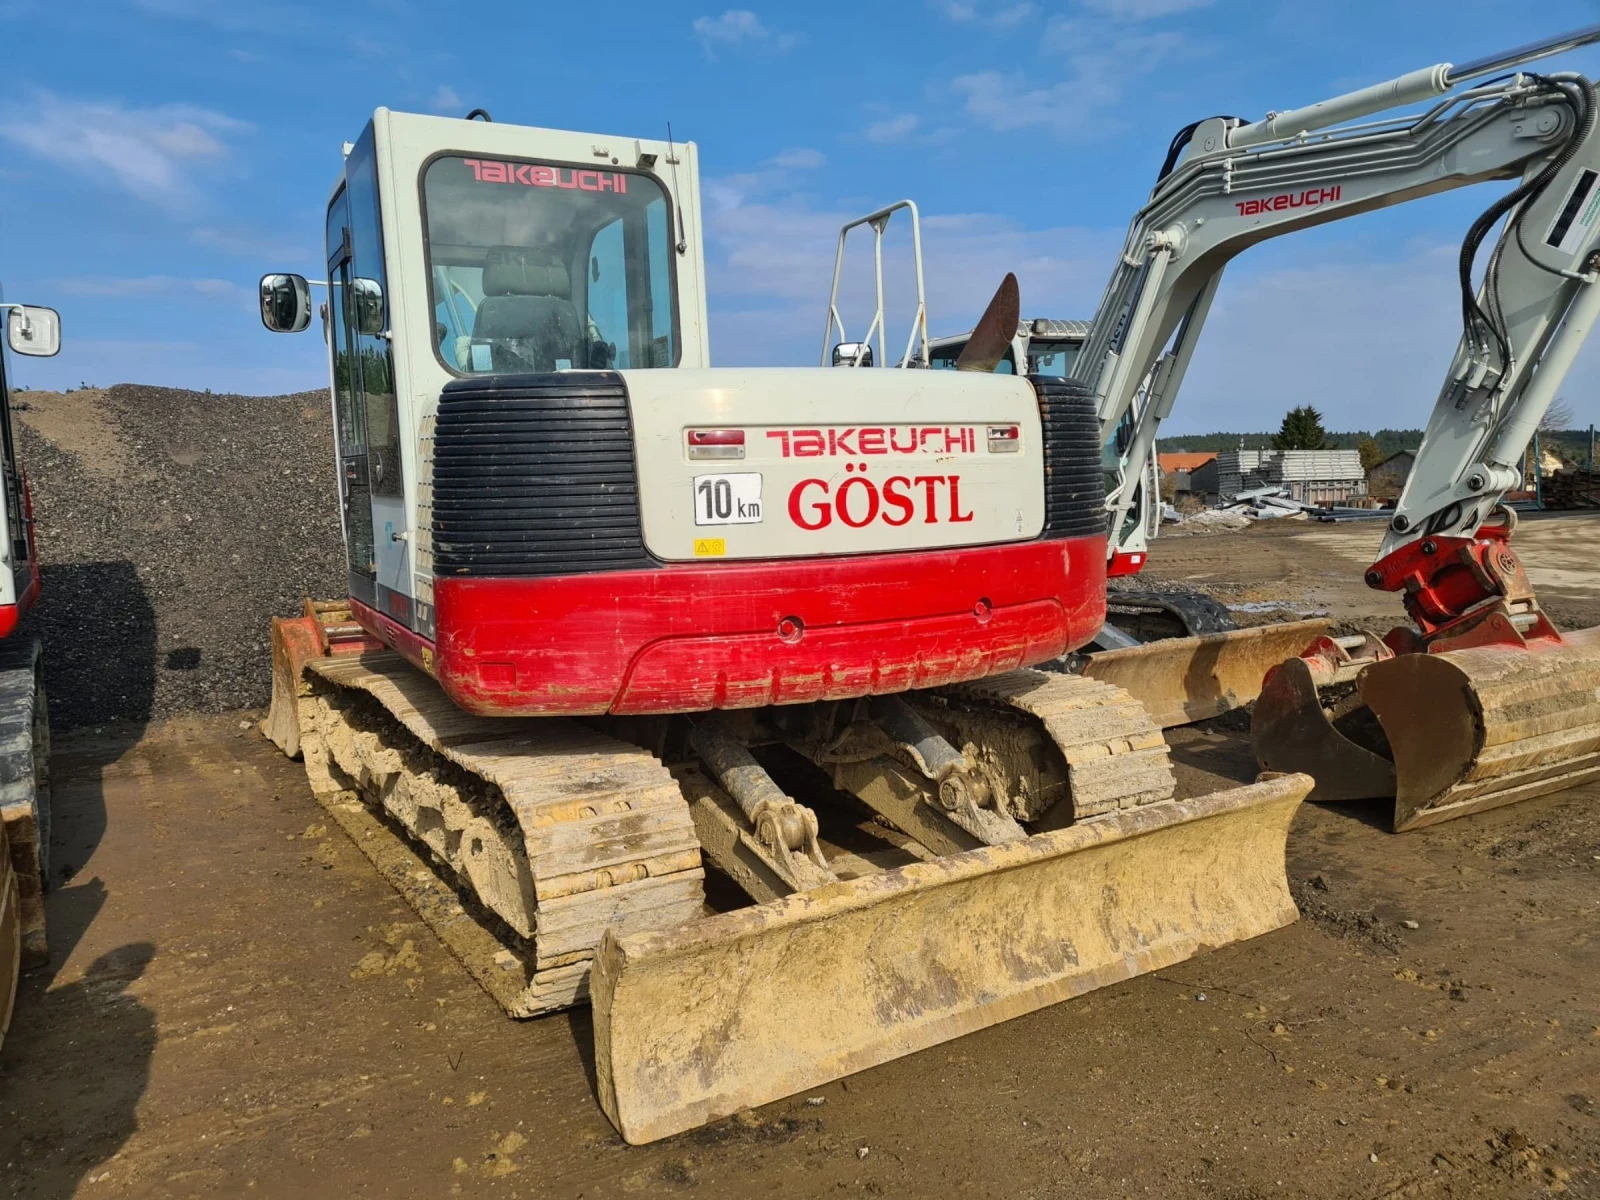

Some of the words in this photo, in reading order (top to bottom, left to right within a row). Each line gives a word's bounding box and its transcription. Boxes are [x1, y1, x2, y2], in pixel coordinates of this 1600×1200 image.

[464, 159, 627, 193] TAKEUCHI
[1235, 185, 1341, 217] TAKEUCHI
[766, 428, 976, 457] TAKEUCHI
[698, 478, 732, 520] 10
[737, 498, 760, 519] km
[788, 463, 973, 530] GÖSTL
